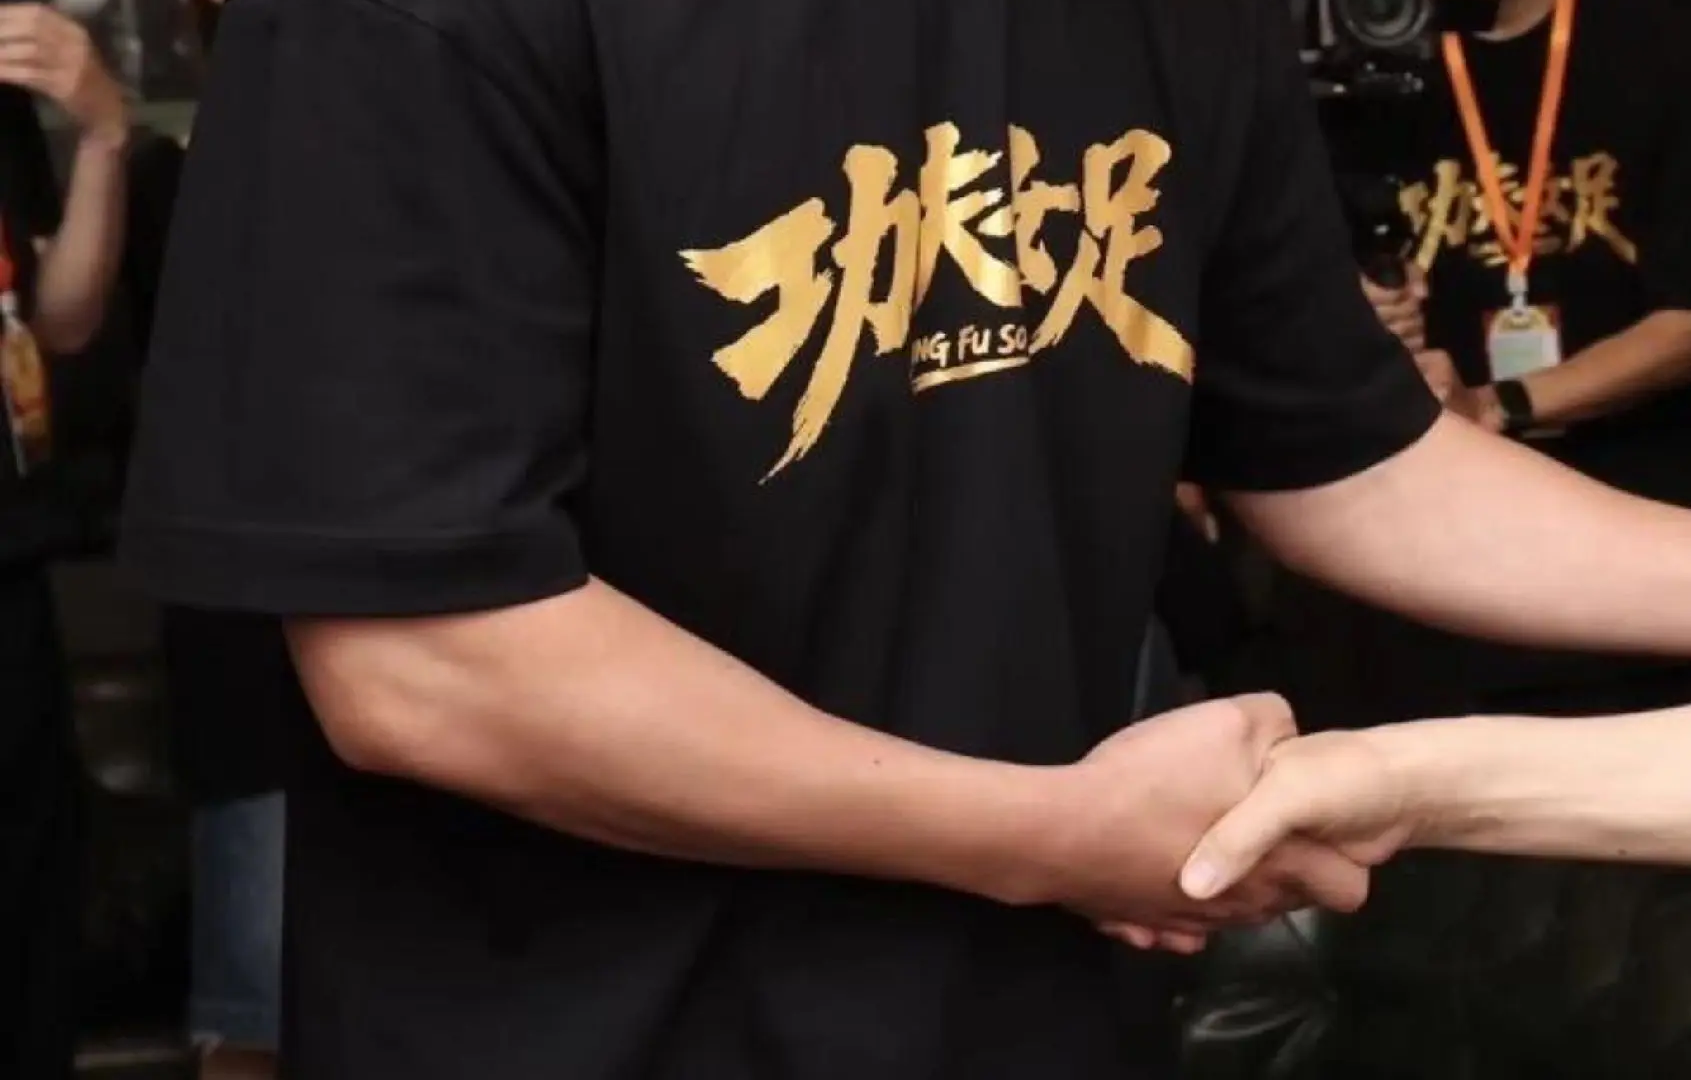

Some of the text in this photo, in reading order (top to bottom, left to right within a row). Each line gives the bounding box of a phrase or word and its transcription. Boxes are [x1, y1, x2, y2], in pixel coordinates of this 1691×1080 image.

[910, 323, 1028, 368] NG FU SO
